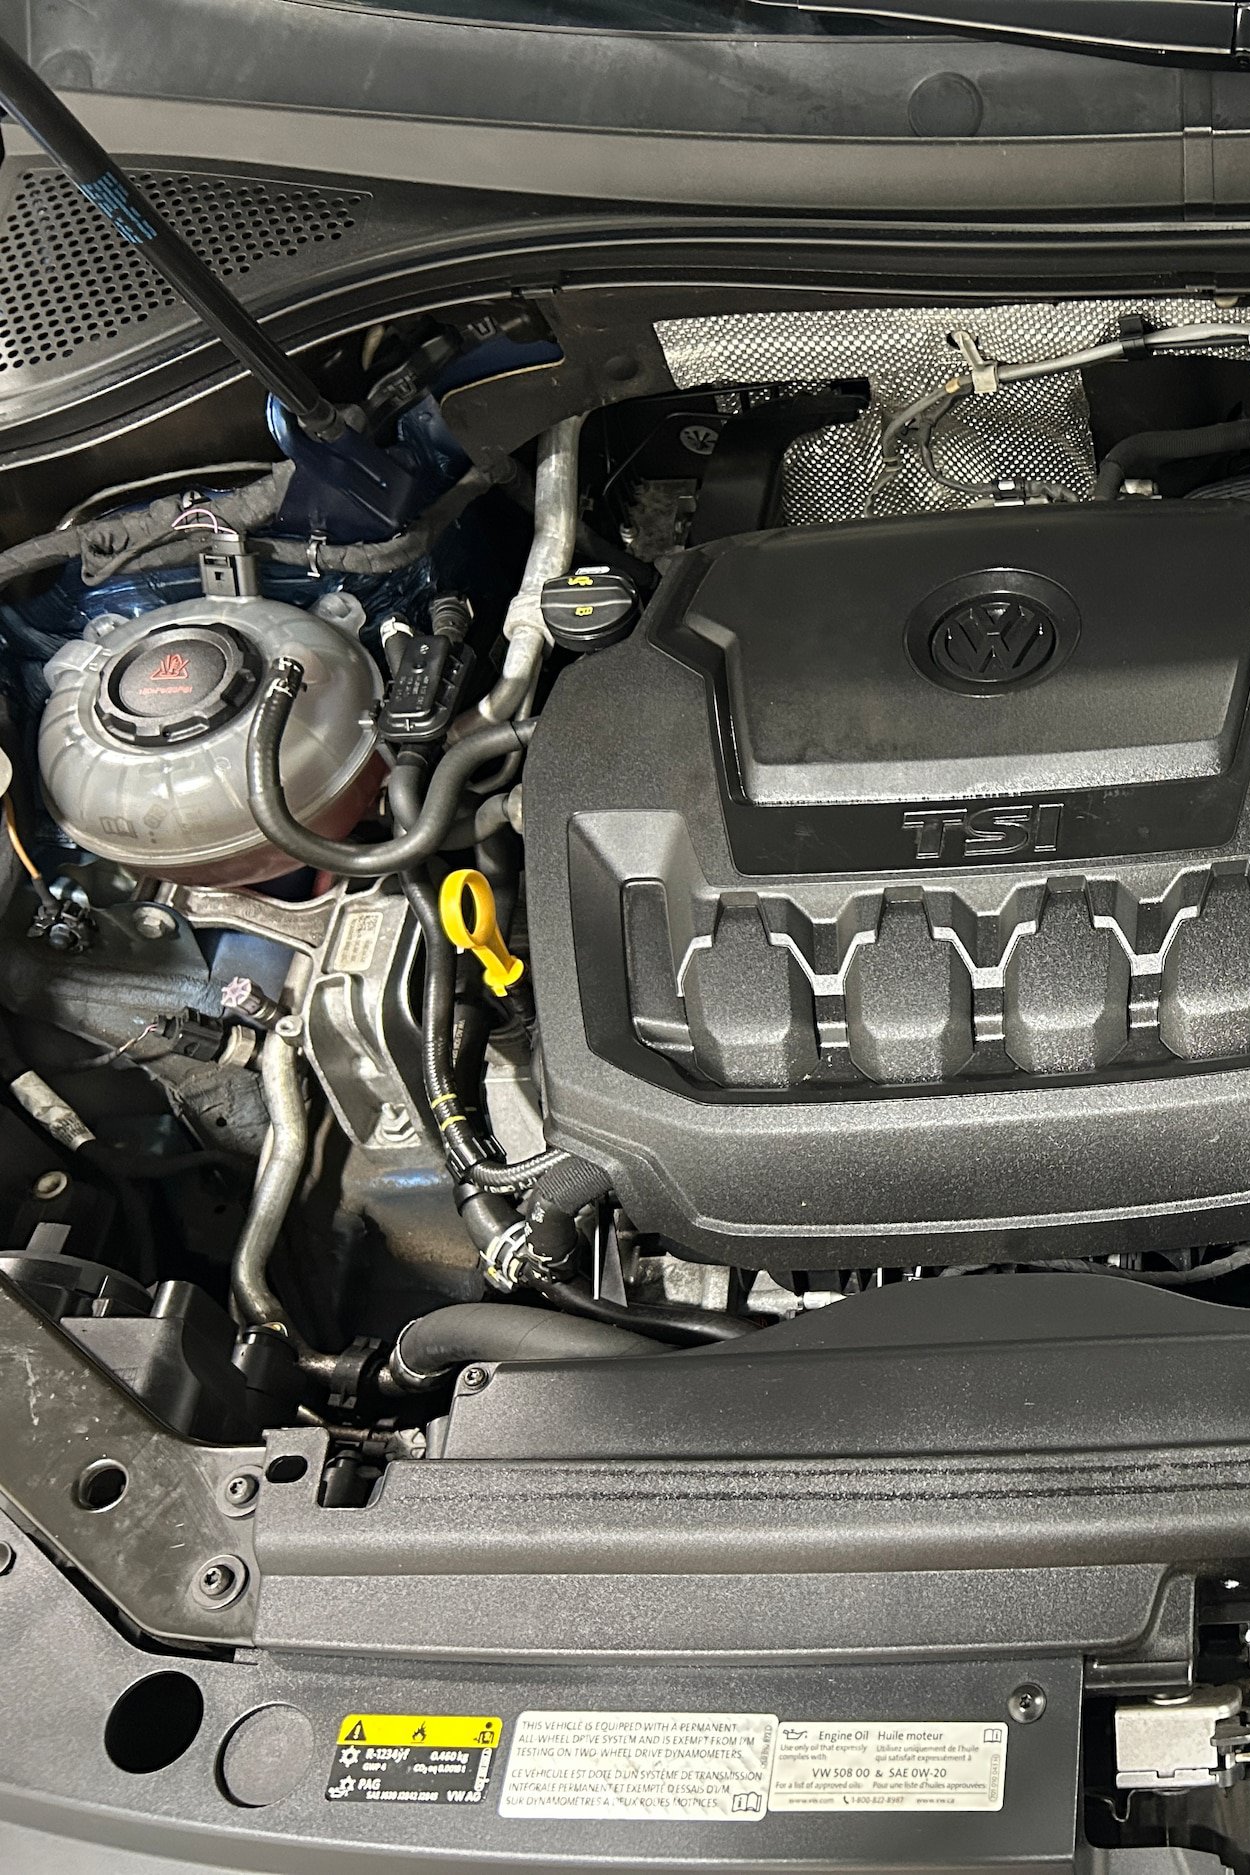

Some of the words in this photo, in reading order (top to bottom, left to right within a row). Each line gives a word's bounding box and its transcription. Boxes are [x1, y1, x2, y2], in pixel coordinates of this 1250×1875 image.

[903, 804, 1065, 860] TSI
[521, 1721, 543, 1729] THIS
[544, 1721, 582, 1730] VEHICLE
[584, 1722, 592, 1730] IS
[595, 1722, 642, 1731] EQUIPPED
[642, 1722, 669, 1731] WITH
[670, 1723, 677, 1731] A
[679, 1723, 736, 1732] PERMANENT
[518, 1734, 571, 1743] ALL-WHEEL
[602, 1735, 636, 1744] SYSTEM
[638, 1736, 660, 1744] AND
[662, 1736, 671, 1744] IS
[672, 1736, 708, 1745] EXEMPT
[710, 1737, 737, 1745] FROM
[818, 1731, 852, 1743] Engine
[854, 1731, 868, 1740] Oil
[877, 1731, 903, 1740] Huile
[905, 1731, 943, 1740] moteur
[516, 1747, 555, 1756] TESTING
[556, 1748, 572, 1756] ON
[634, 1749, 662, 1757] DRIVE
[835, 1744, 867, 1752] expressly
[363, 1747, 410, 1763] R-1234yf
[456, 1751, 469, 1763] kg
[778, 1753, 809, 1761] complies
[875, 1753, 886, 1761] qui
[511, 1768, 523, 1777] CE
[570, 1769, 586, 1778] EST
[680, 1770, 693, 1779] DE
[694, 1771, 762, 1780] TRANSMISSION
[811, 1768, 830, 1777] VW
[833, 1768, 852, 1777] 508
[855, 1768, 870, 1777] 00
[875, 1768, 883, 1777] &
[888, 1768, 907, 1777] SAE
[911, 1768, 947, 1777] 0W-20
[357, 1778, 381, 1790] PAG
[558, 1783, 613, 1792] PERMANENT
[614, 1783, 624, 1792] ET
[814, 1781, 847, 1789] approved
[445, 1790, 466, 1801] VW
[505, 1795, 523, 1805] SUR
